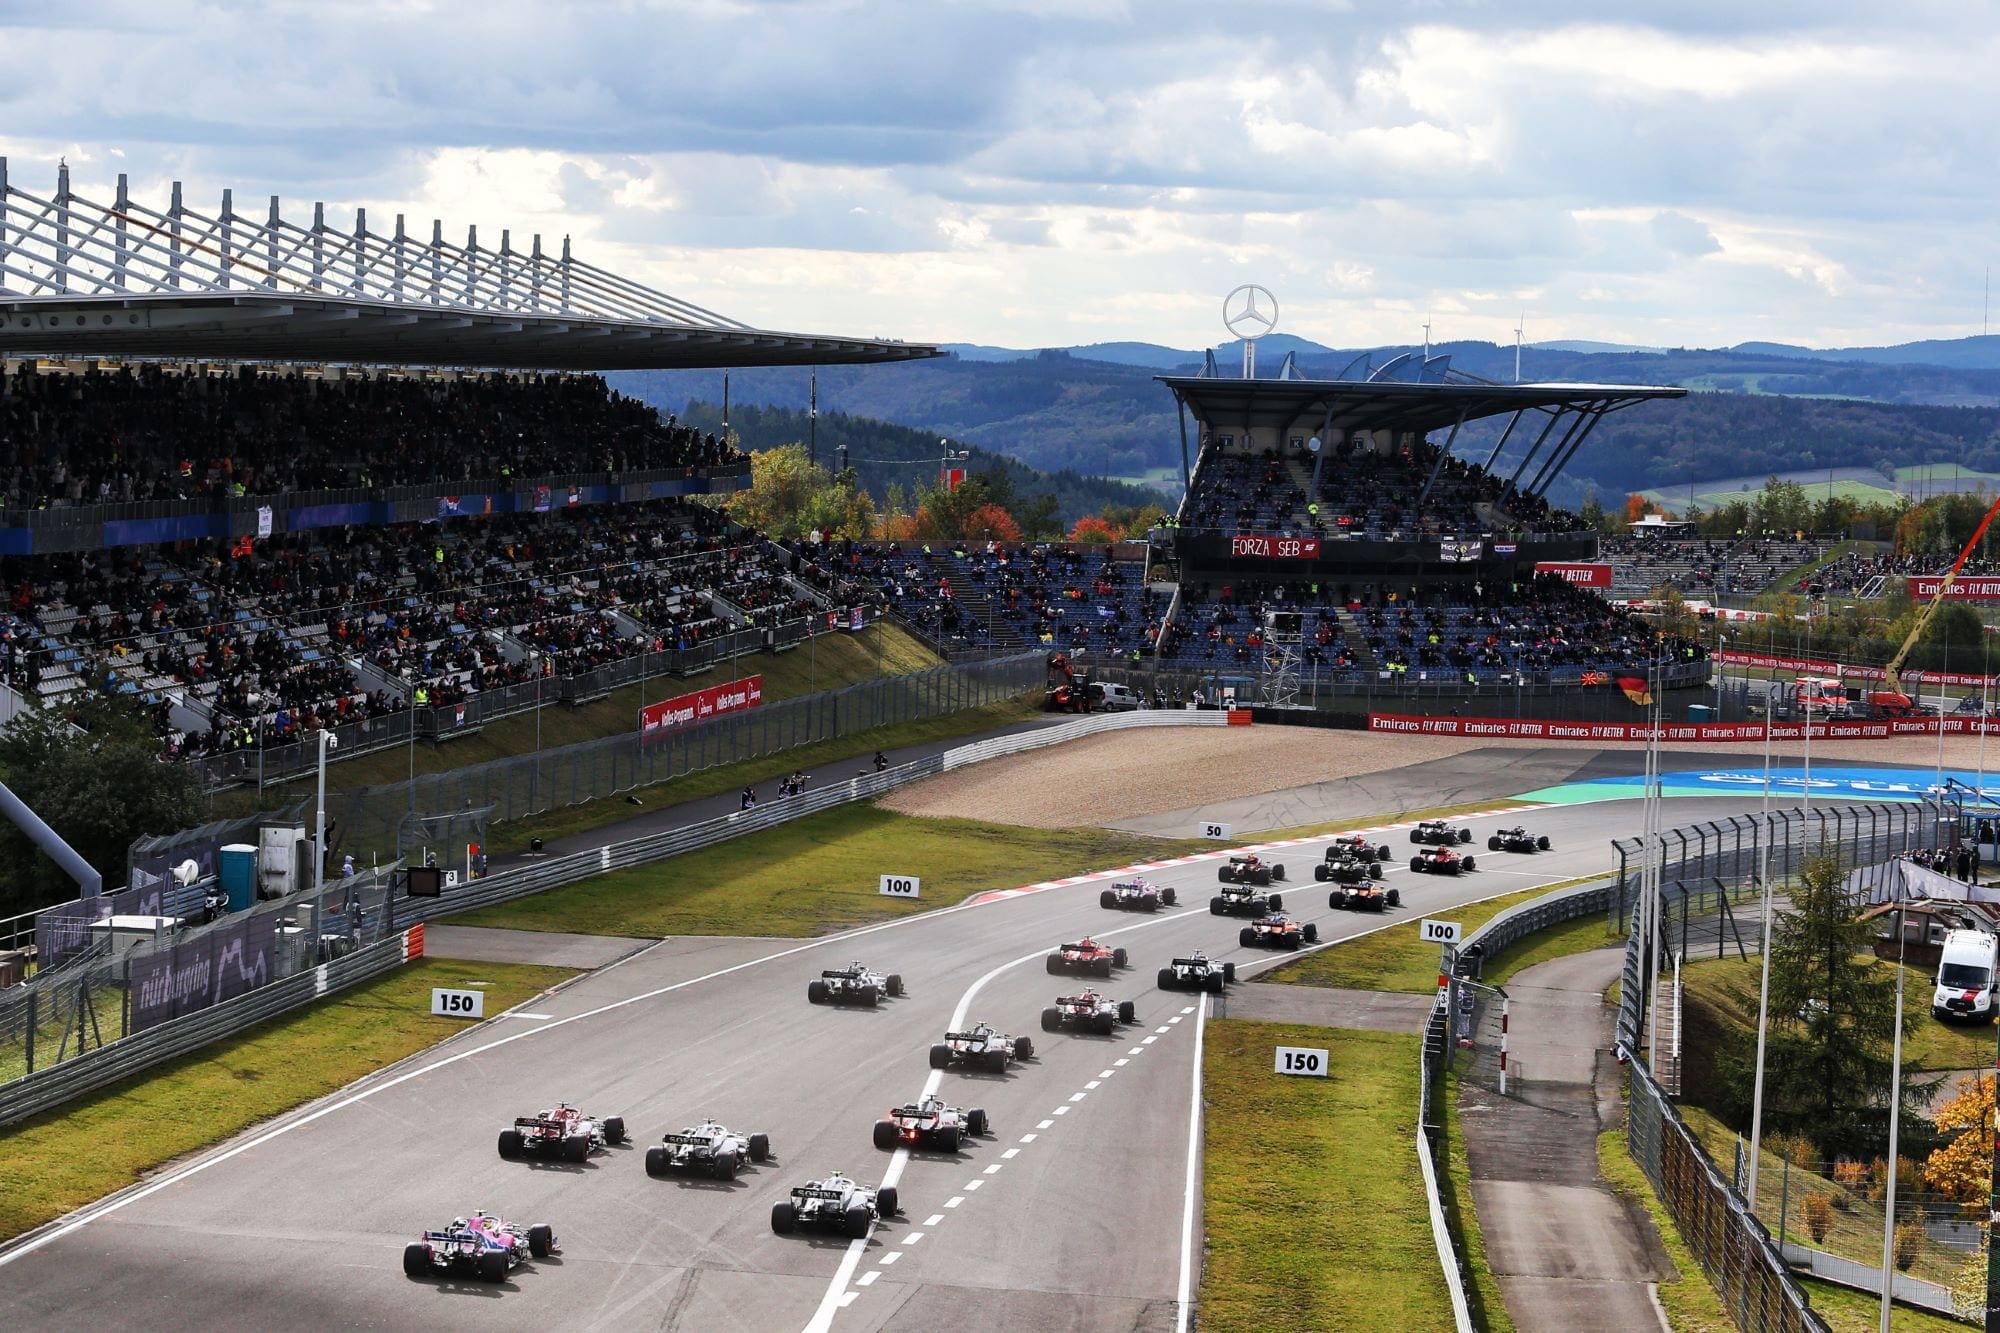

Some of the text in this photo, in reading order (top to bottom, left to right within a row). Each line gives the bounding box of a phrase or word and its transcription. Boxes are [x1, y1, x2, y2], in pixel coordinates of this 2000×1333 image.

[1232, 539, 1300, 556] FORZA SEB
[1566, 570, 1592, 582] BETTER
[1918, 582, 1964, 594] Emites
[1969, 584, 1980, 594] FLY
[1373, 717, 1457, 732] Emirates FLY BETTER
[1465, 722, 1542, 735] Emirates FLY BETTER
[1893, 721, 1962, 731] Emirates FLY ETTER
[1971, 722, 2000, 731] Emira
[1550, 726, 1624, 738] Emirates FLY BETTER
[1631, 728, 1666, 738] Emiraes
[1679, 728, 1696, 738] BETTER
[1702, 728, 1734, 738] Emirates
[1831, 726, 1860, 736] Emirates
[1207, 826, 1221, 836] 50
[448, 872, 454, 881] 3
[887, 879, 911, 892] 100
[1428, 924, 1453, 939] 100
[140, 953, 210, 1009] nürburgring
[441, 994, 473, 1012] 150
[1285, 1053, 1318, 1071] 150
